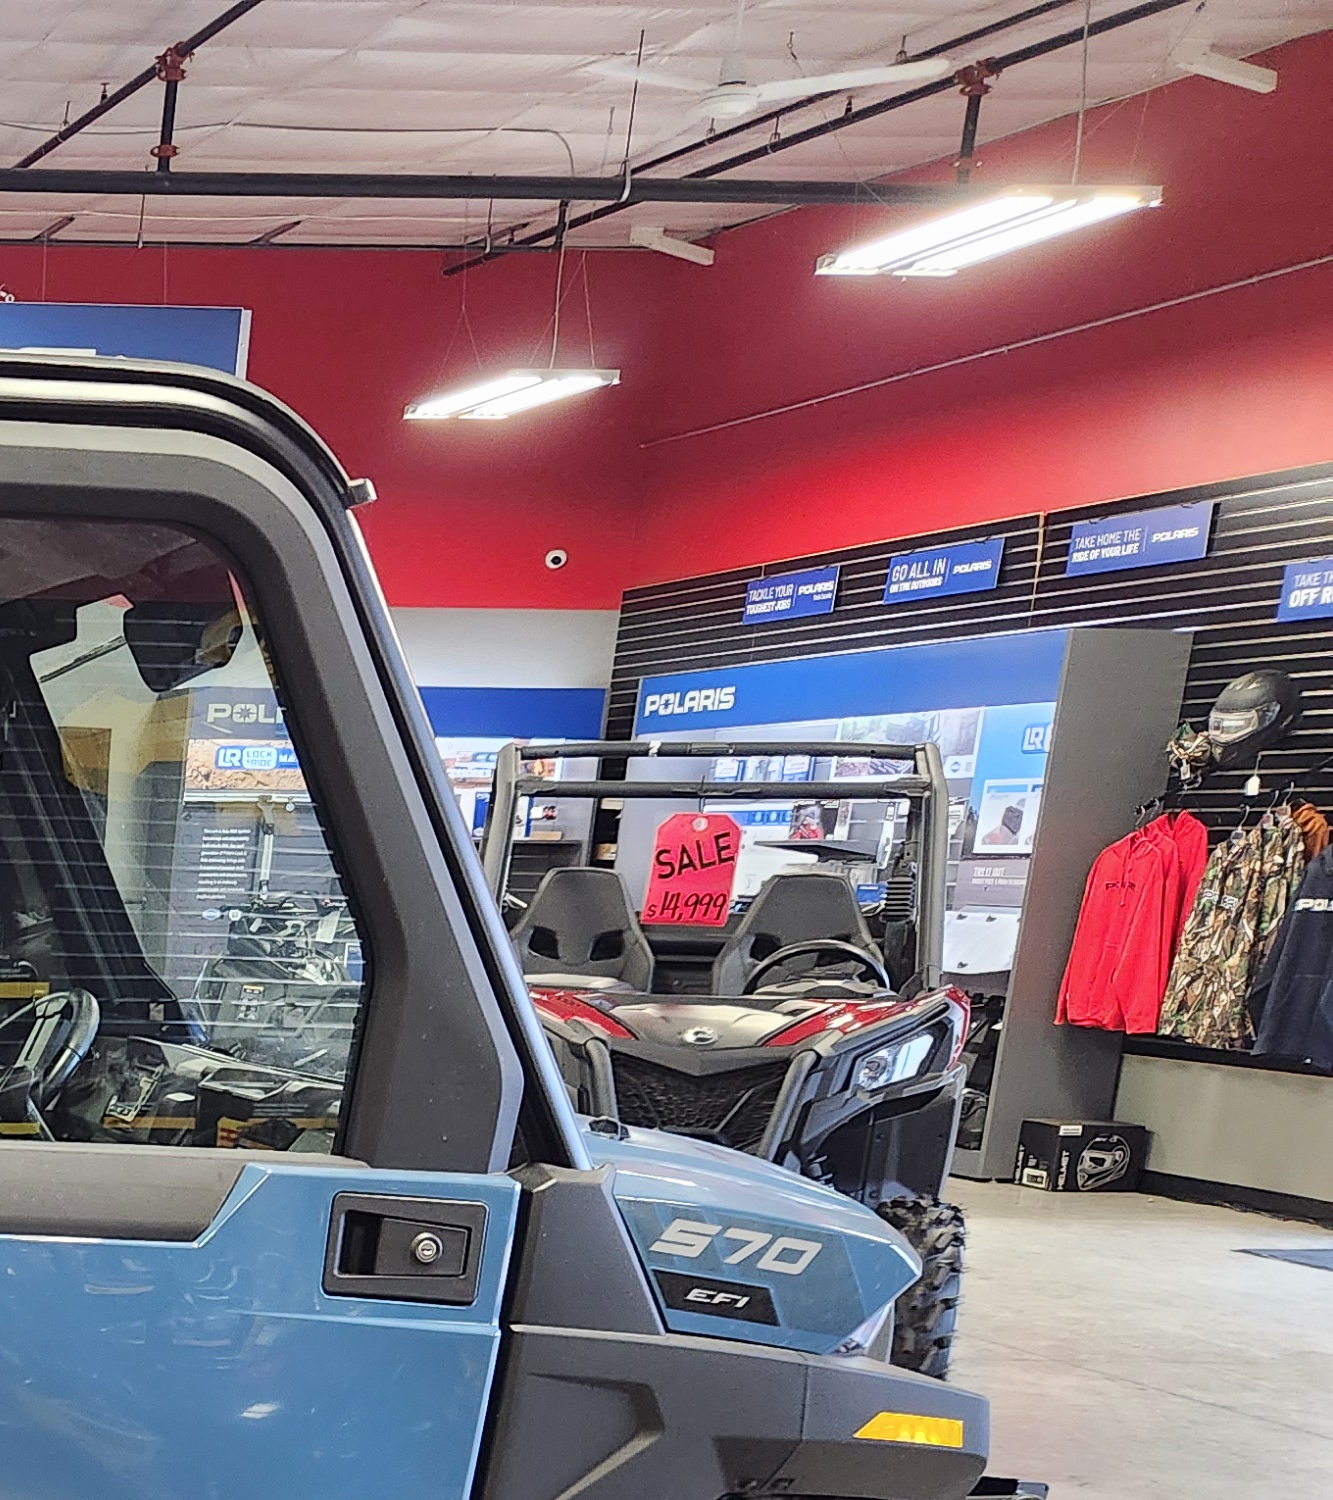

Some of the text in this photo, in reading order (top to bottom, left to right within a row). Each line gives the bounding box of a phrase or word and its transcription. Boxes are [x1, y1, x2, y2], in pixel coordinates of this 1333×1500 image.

[1075, 528, 1142, 549] TAKE HOME THE
[1152, 527, 1199, 543] POLARIS
[1072, 543, 1140, 563] RIDE OF YOUR LIFE
[891, 557, 946, 581] GO ALL IN
[952, 559, 992, 574] POLARIS
[798, 580, 834, 595] POLARIS
[1294, 571, 1322, 588] TAKE
[748, 583, 794, 602] TACKLE YOUR
[1289, 587, 1321, 608] OFF
[644, 686, 735, 718] POLARIS
[246, 750, 273, 758] LOCK
[655, 831, 735, 879] SALE
[647, 890, 727, 921] $14,999
[649, 1218, 823, 1276] 570
[684, 1287, 751, 1309] EFI
